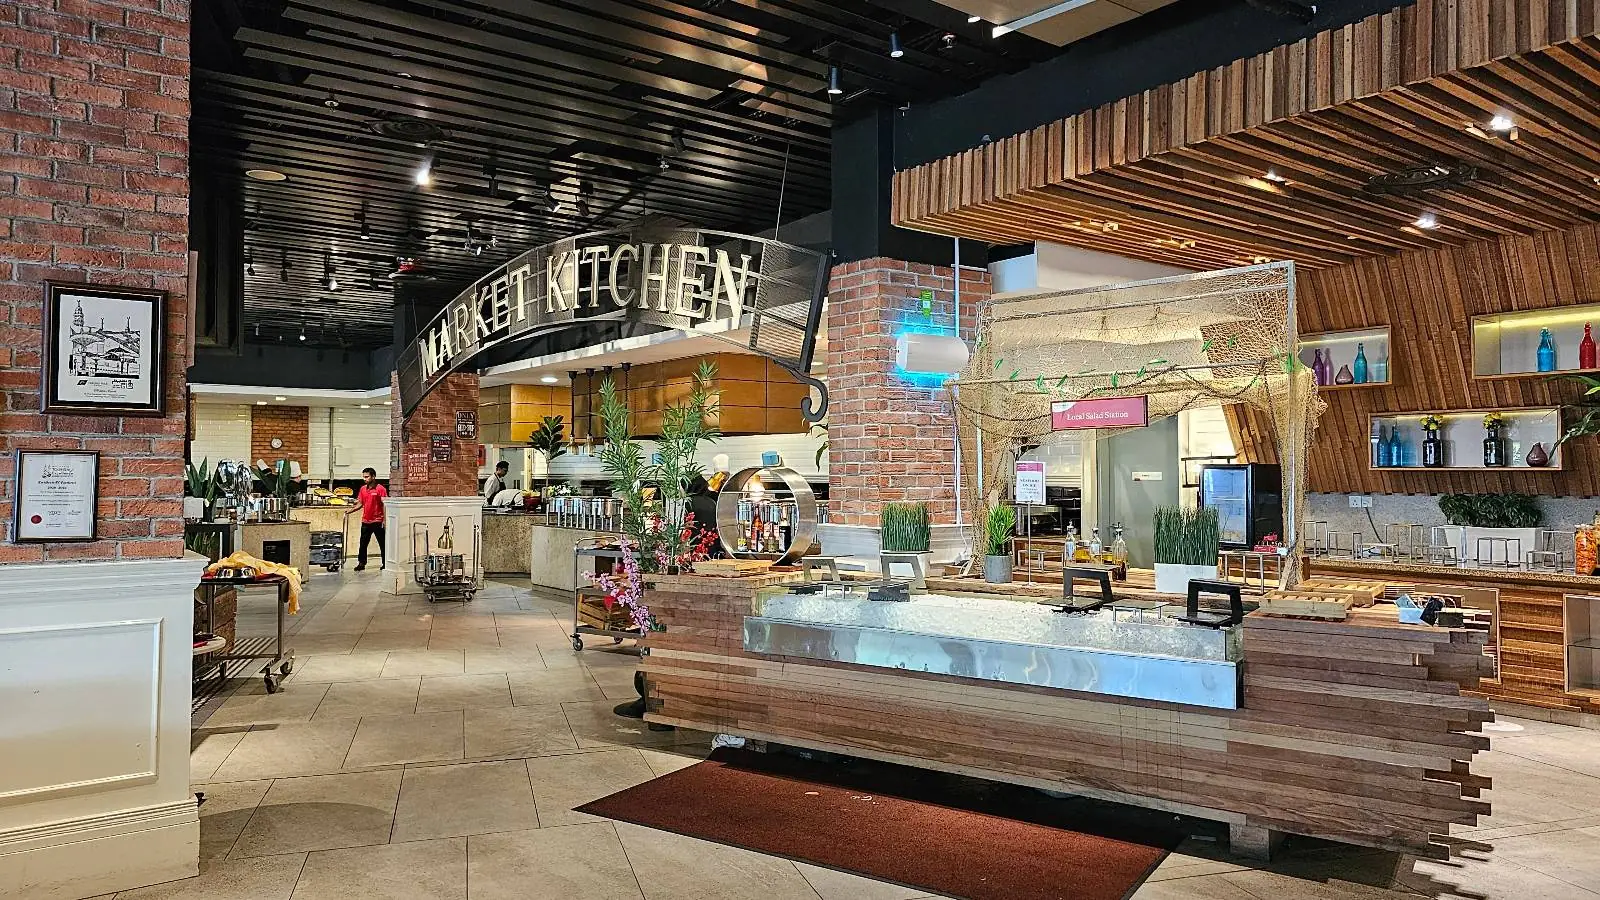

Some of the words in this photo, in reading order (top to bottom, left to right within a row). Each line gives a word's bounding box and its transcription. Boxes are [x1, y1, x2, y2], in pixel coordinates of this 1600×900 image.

[418, 263, 531, 383] MARKET
[545, 242, 752, 331] KITCHEN
[1067, 413, 1085, 421] Local
[1104, 411, 1129, 419] Station
